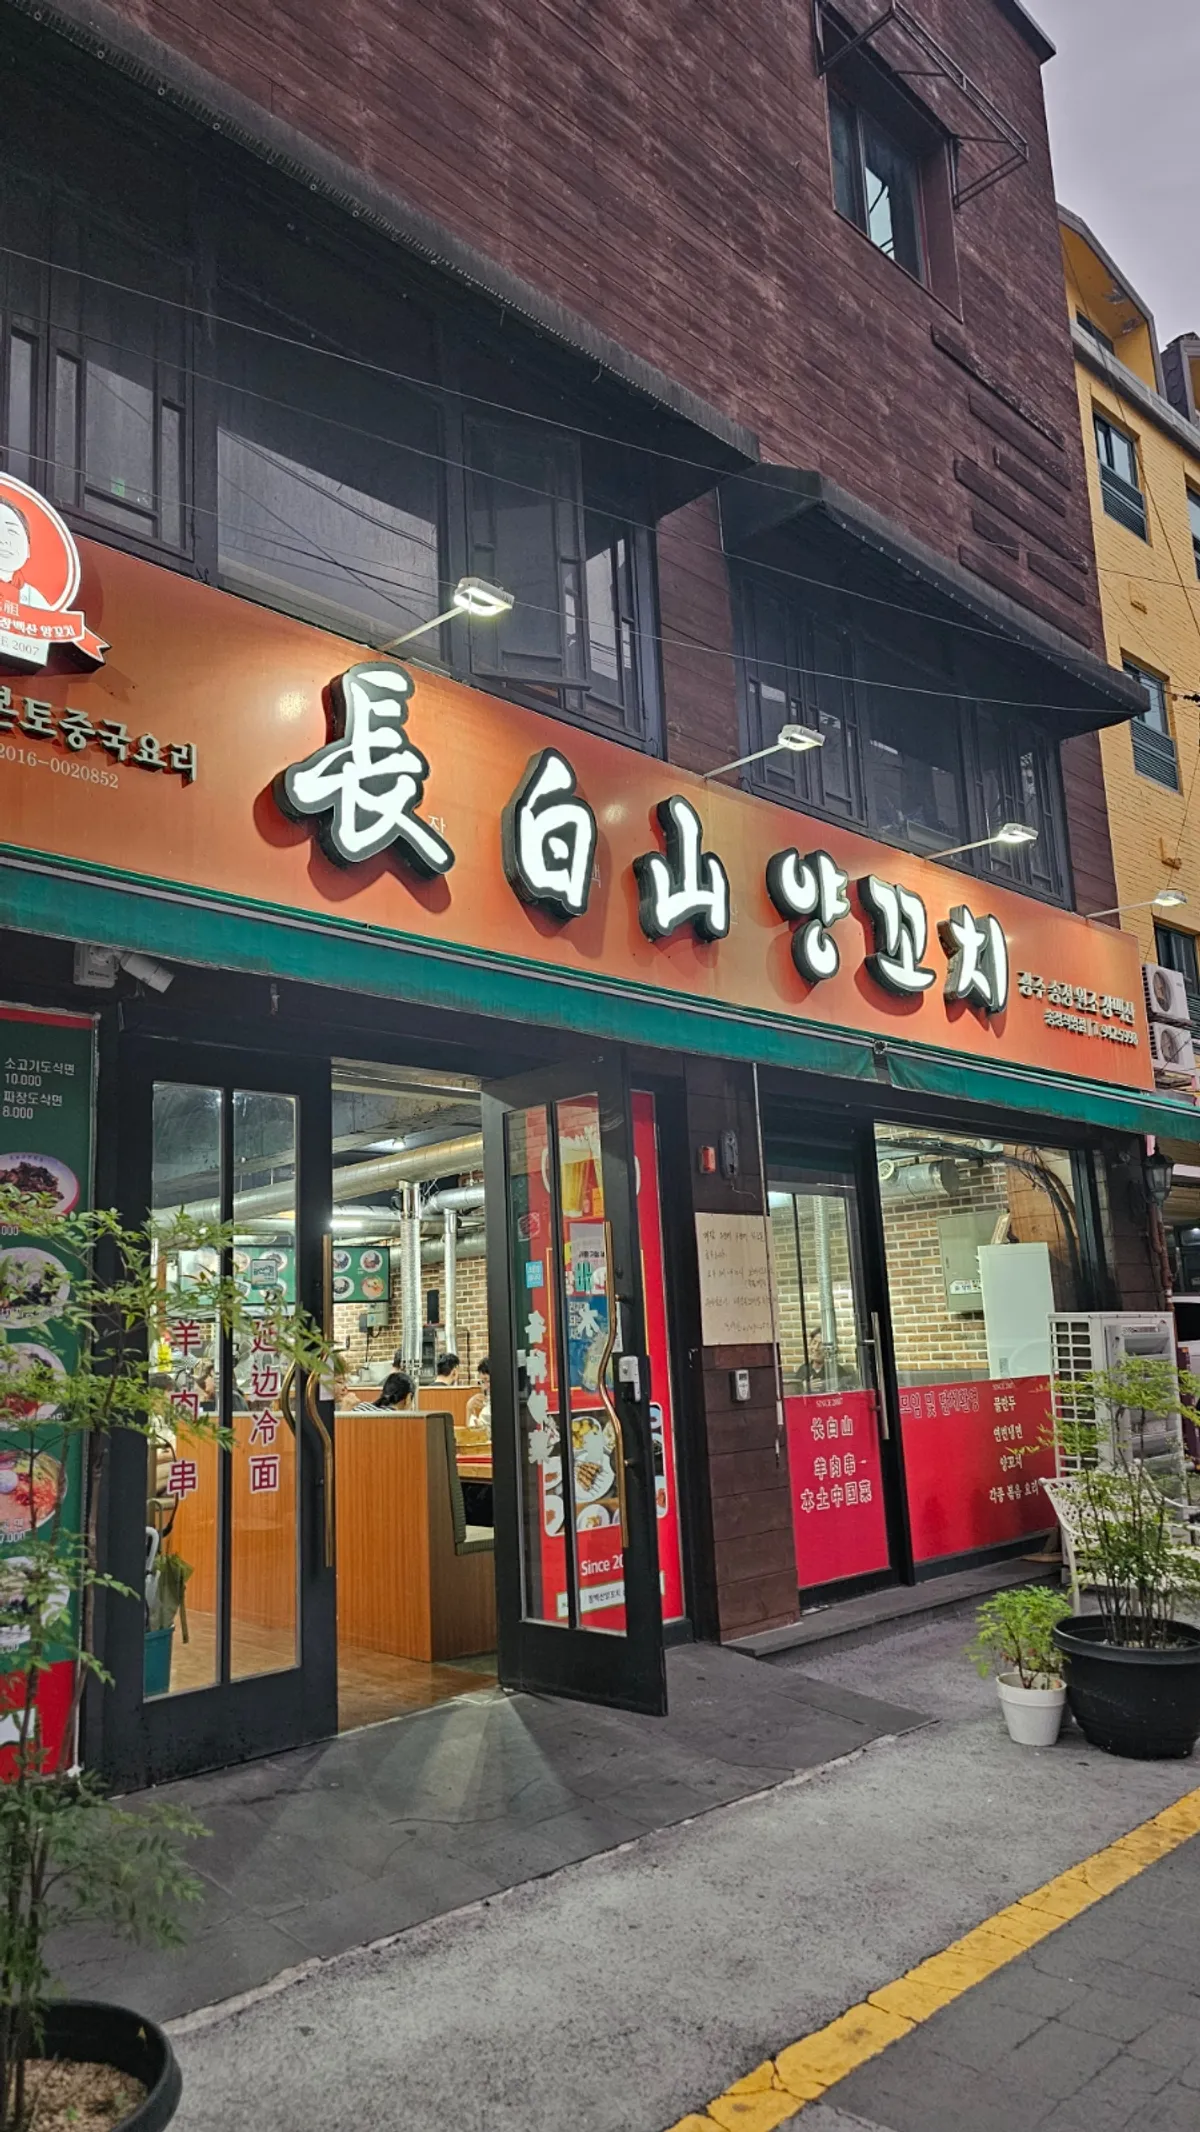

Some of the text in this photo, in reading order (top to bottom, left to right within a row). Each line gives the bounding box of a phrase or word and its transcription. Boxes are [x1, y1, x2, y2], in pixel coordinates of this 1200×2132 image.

[12, 640, 40, 657] 2007
[0, 742, 120, 790] 2016-0020852
[288, 666, 728, 935] 長白山
[779, 850, 1008, 1010] 양꼬치
[5, 1057, 75, 1076] 소고기도삭면
[810, 1415, 854, 1441] 长白山
[813, 1452, 856, 1481] 羊肉串
[800, 1479, 872, 1513] 本土中国菜
[581, 1558, 610, 1576] Since
